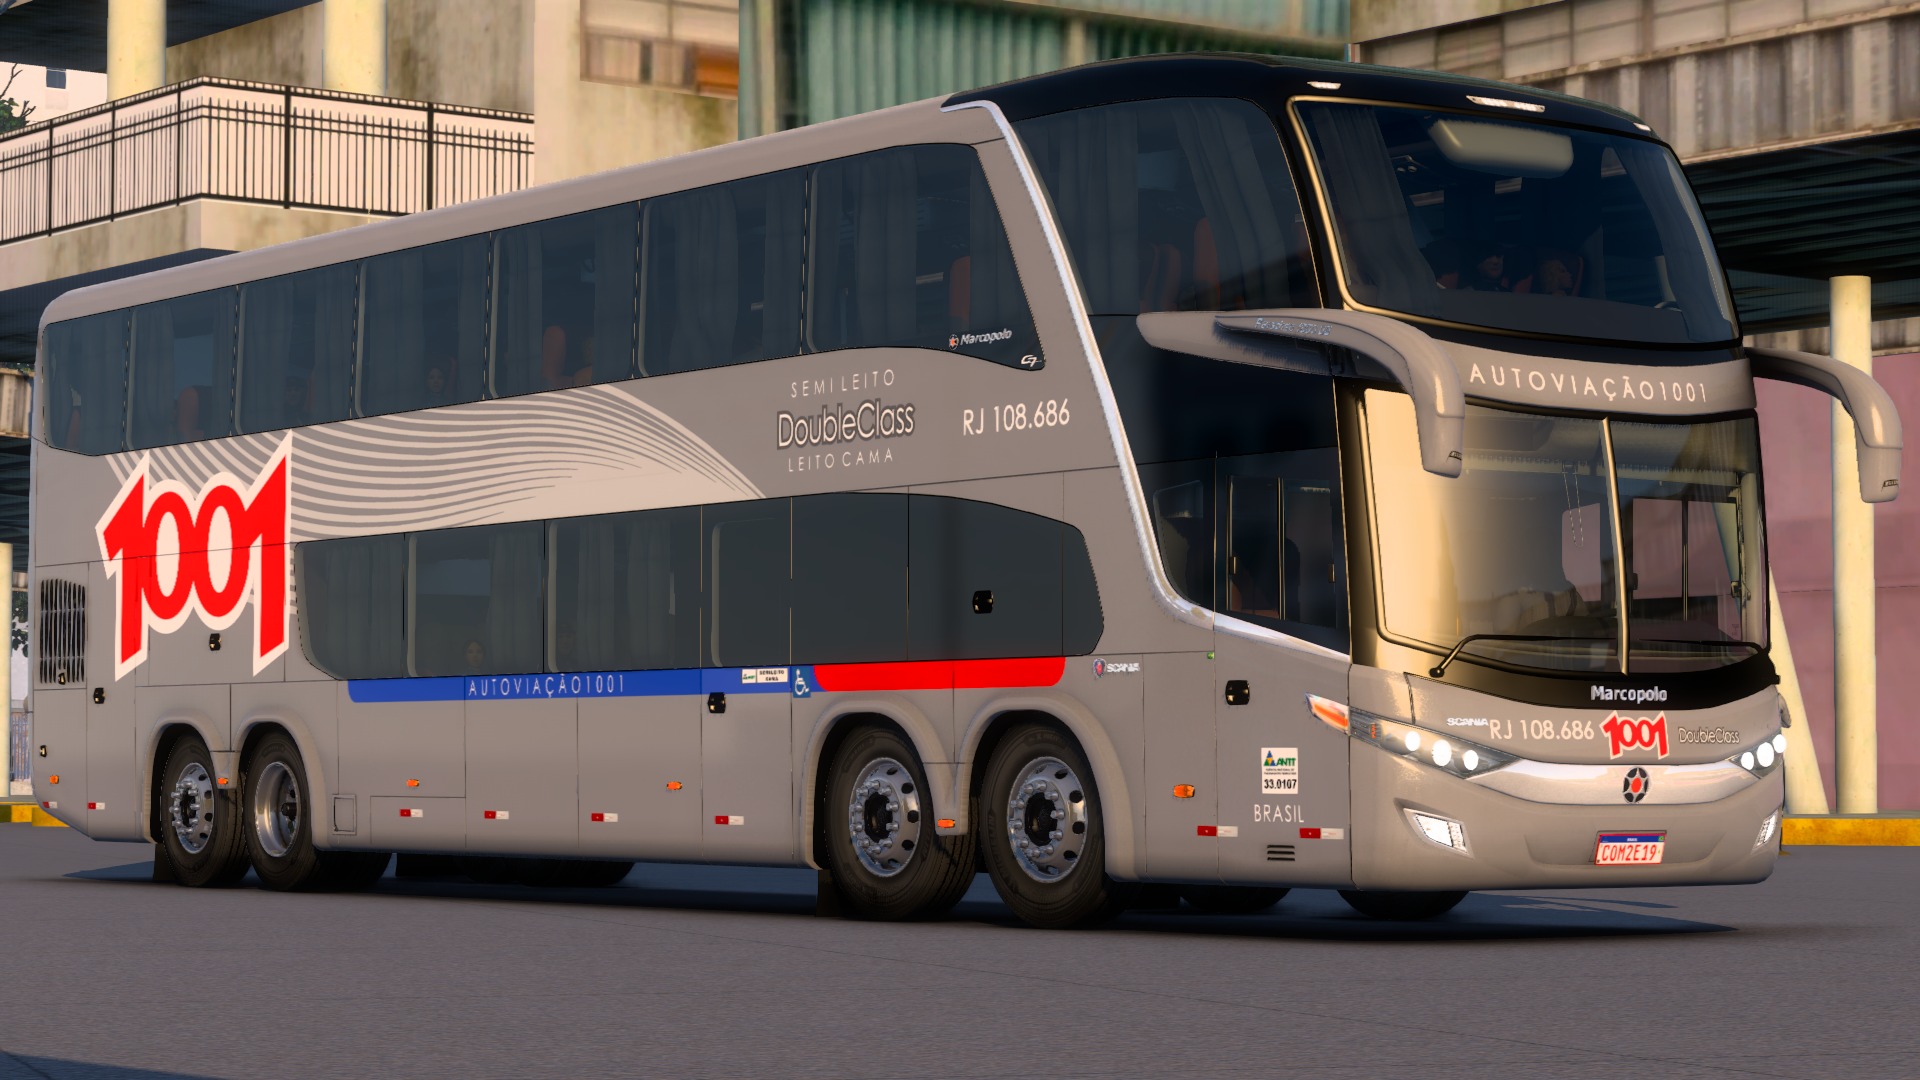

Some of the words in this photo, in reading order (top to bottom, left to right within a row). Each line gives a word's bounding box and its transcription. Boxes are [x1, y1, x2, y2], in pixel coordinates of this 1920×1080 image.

[960, 328, 1012, 345] Marcopolo
[777, 399, 915, 449] DoubleClass
[963, 409, 984, 436] RJ
[993, 398, 1070, 432] 108.686
[97, 436, 291, 677] 1001
[1590, 685, 1667, 704] Marcopolo
[1446, 718, 1489, 726] SCANIA
[1489, 719, 1513, 740] RJ
[1520, 719, 1595, 740] 108.686
[1600, 710, 1670, 760] 1001
[1678, 726, 1740, 744] DoubleClass
[1276, 757, 1296, 767] ANTT
[1264, 778, 1297, 790] 33.0107
[1254, 804, 1304, 823] BRASIL
[1601, 844, 1657, 862] COM2E19
